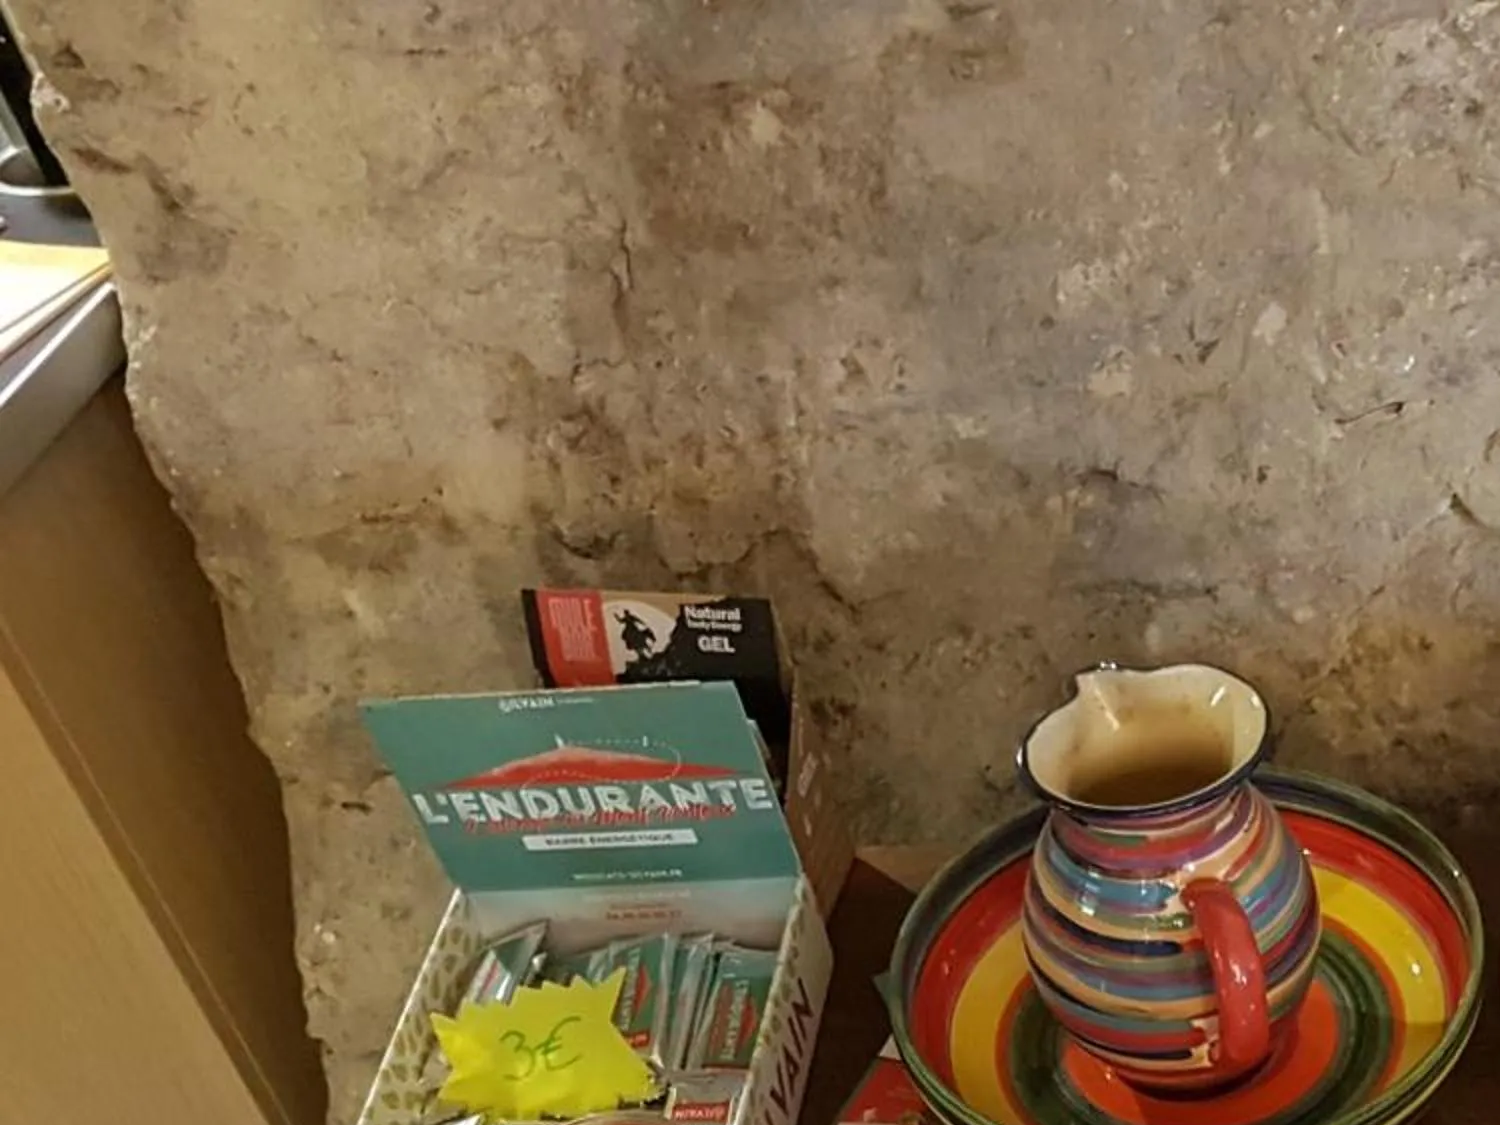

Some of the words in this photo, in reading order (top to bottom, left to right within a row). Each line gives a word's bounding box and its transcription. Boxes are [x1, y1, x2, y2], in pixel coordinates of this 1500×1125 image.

[684, 605, 742, 622] Natural
[698, 635, 736, 653] GEL
[411, 779, 774, 824] L'ENDURANTE
[499, 1014, 582, 1081] 3€
